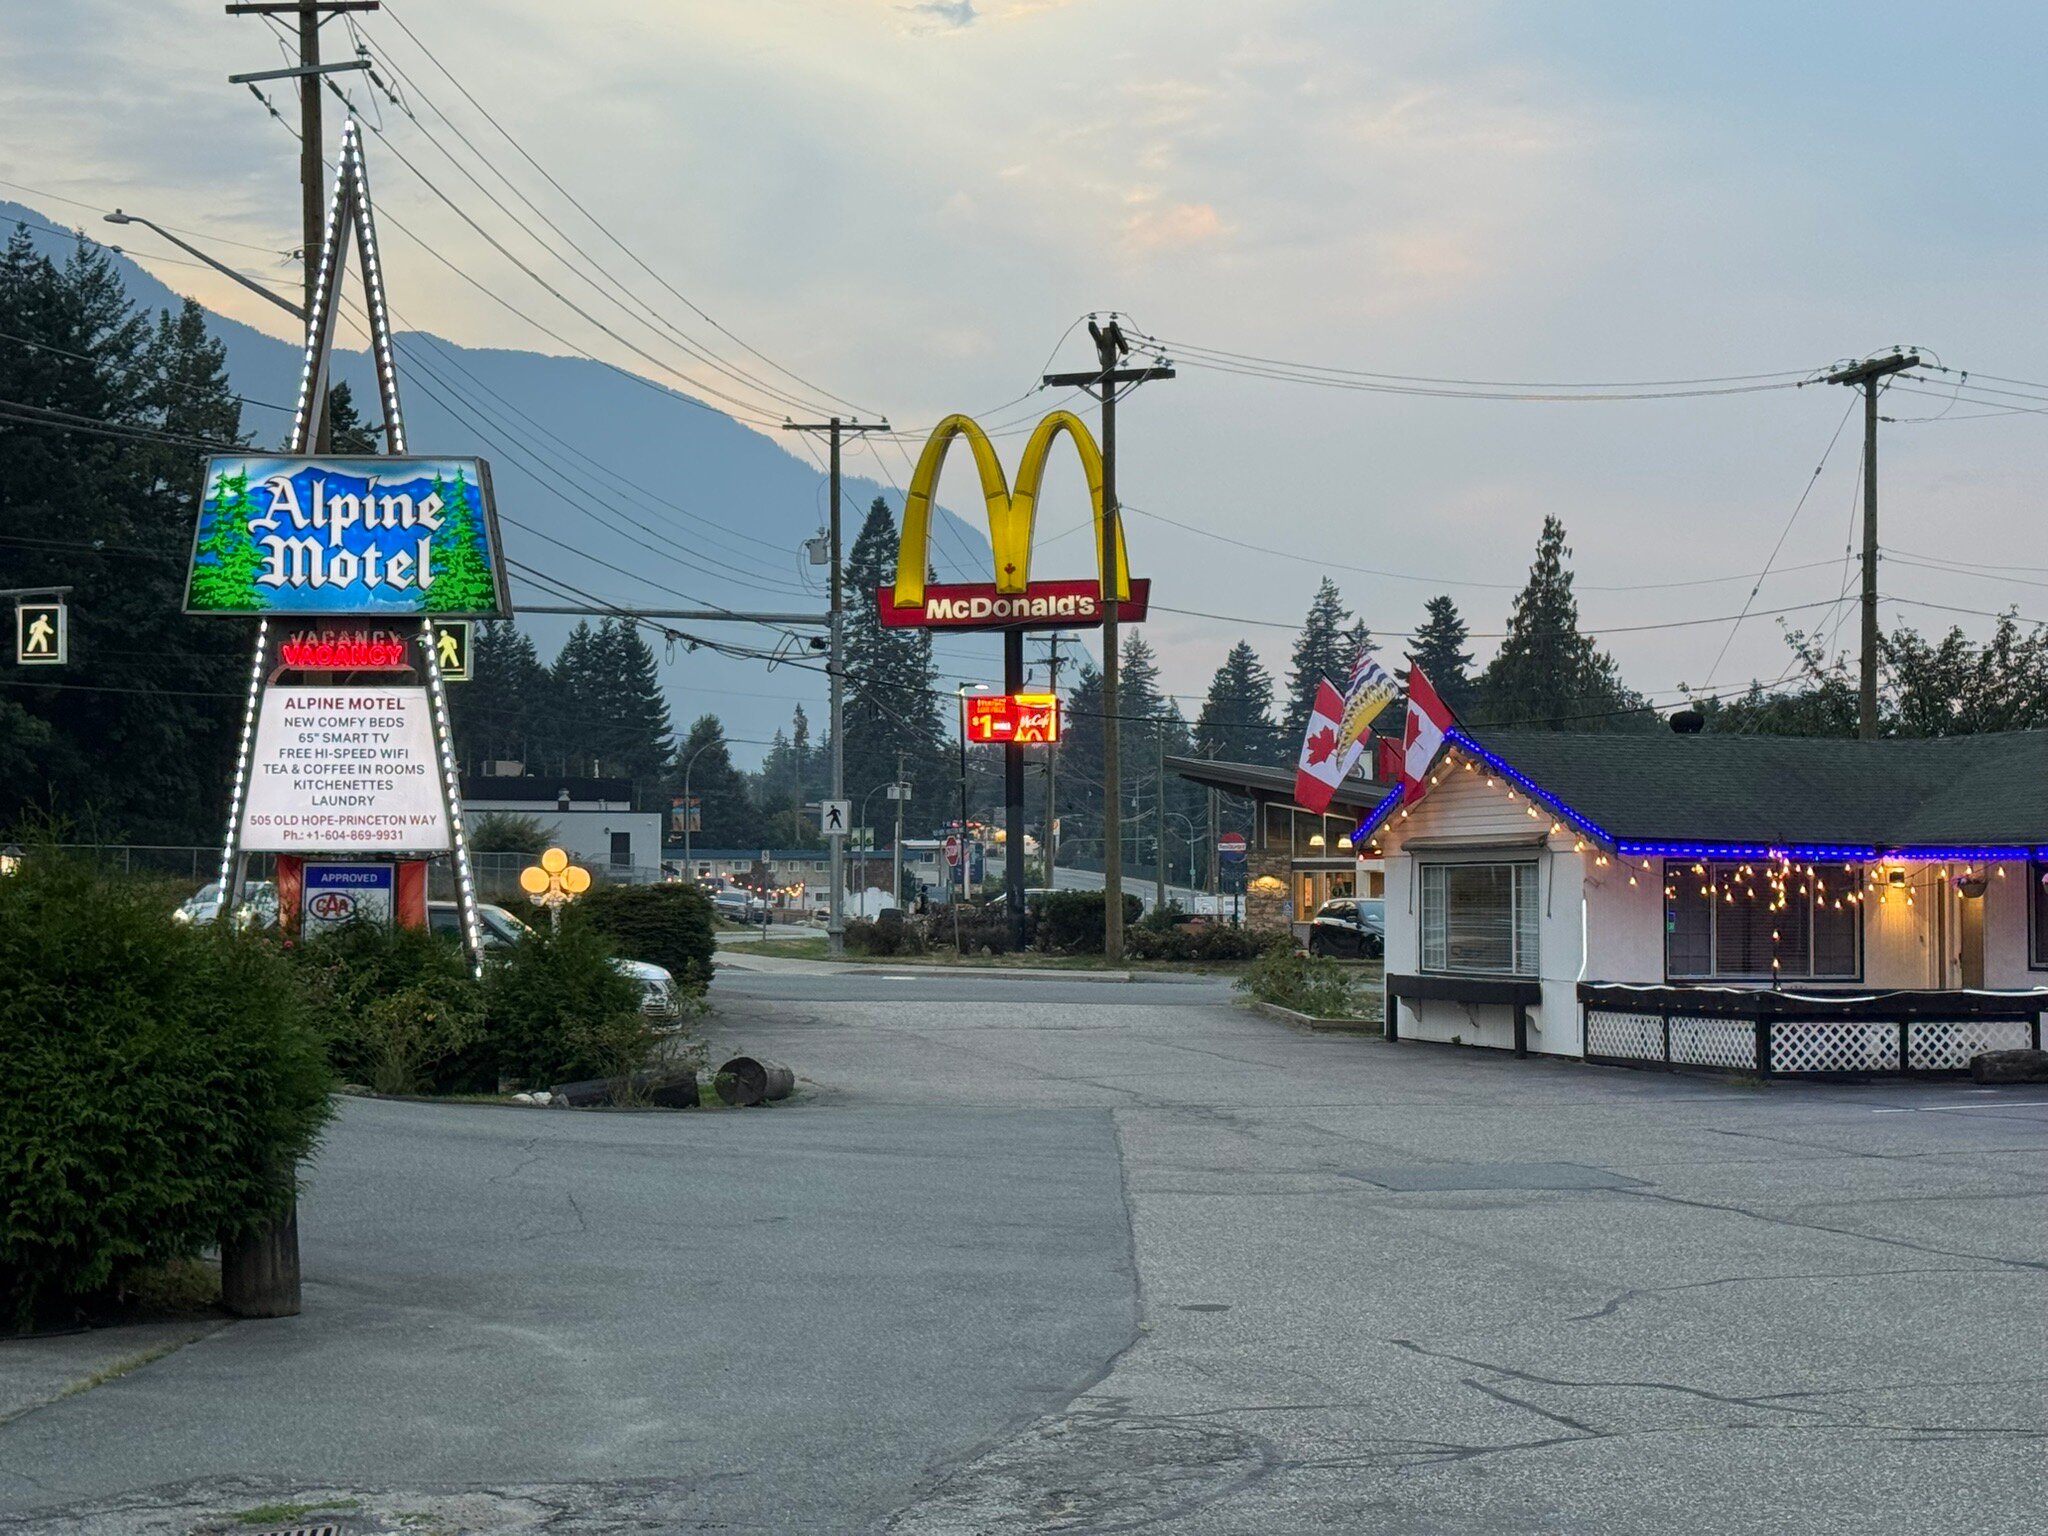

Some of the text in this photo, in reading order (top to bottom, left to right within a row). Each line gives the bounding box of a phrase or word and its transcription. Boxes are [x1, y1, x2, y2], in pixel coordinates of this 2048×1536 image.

[248, 475, 447, 547] Alpine
[257, 534, 436, 591] Motel
[926, 594, 1096, 620] McDonald's
[282, 645, 403, 666] VACANCY
[284, 697, 406, 710] ALPINE MOTEL
[284, 716, 405, 728] NEW COMFY BEDS
[298, 732, 390, 744] 65" SMART TV
[279, 748, 409, 759] FREE HI-SPEED WIFI
[262, 763, 425, 775] TEA & COFFEE IN ROOMS
[293, 779, 394, 791] KITCHENETTES
[311, 795, 376, 807] LAUNDRY
[250, 814, 437, 826] 505 OLD HOPE-PRINCETON WAY
[306, 829, 404, 841] +1-604-869-9931
[945, 845, 958, 857] STOP
[321, 873, 378, 883] APPROVED
[315, 894, 349, 917] CAA
